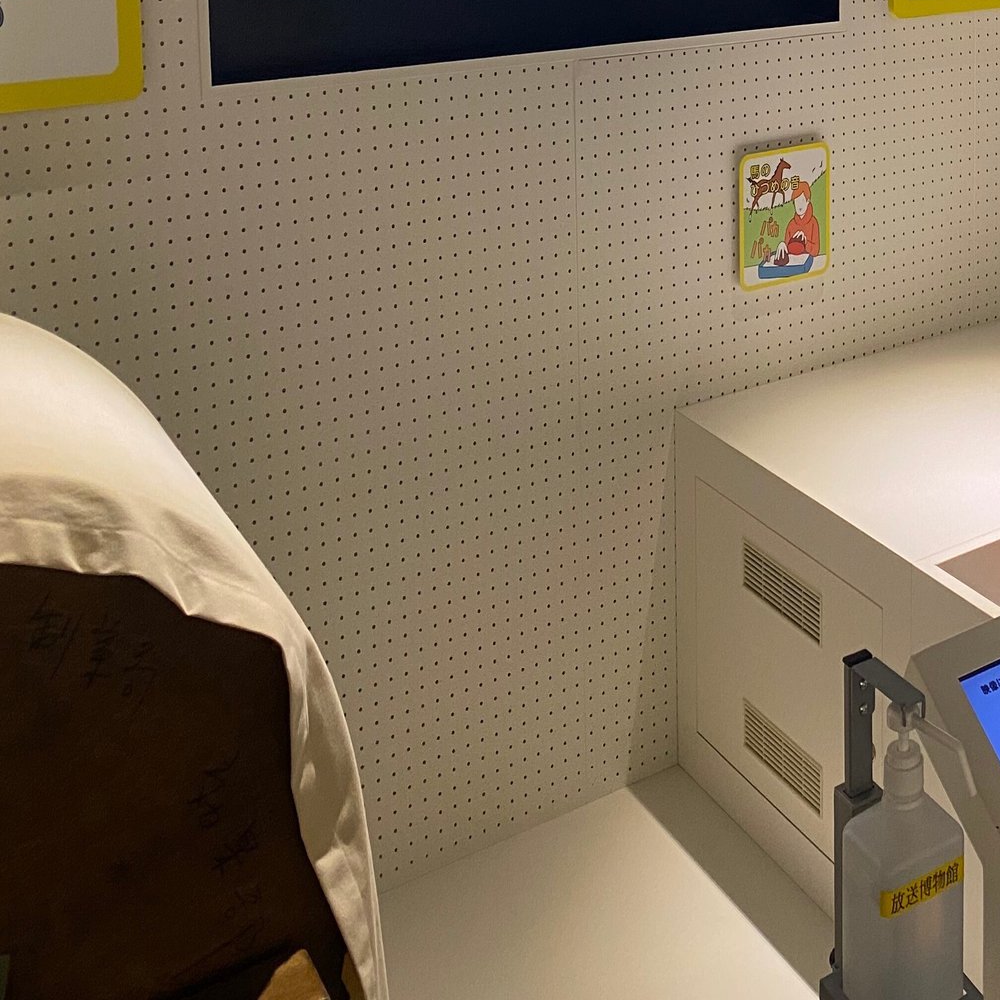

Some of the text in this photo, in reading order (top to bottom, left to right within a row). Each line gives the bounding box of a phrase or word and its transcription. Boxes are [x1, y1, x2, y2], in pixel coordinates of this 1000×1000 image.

[750, 163, 771, 180] 馬の
[891, 862, 959, 914] 放送博物館
